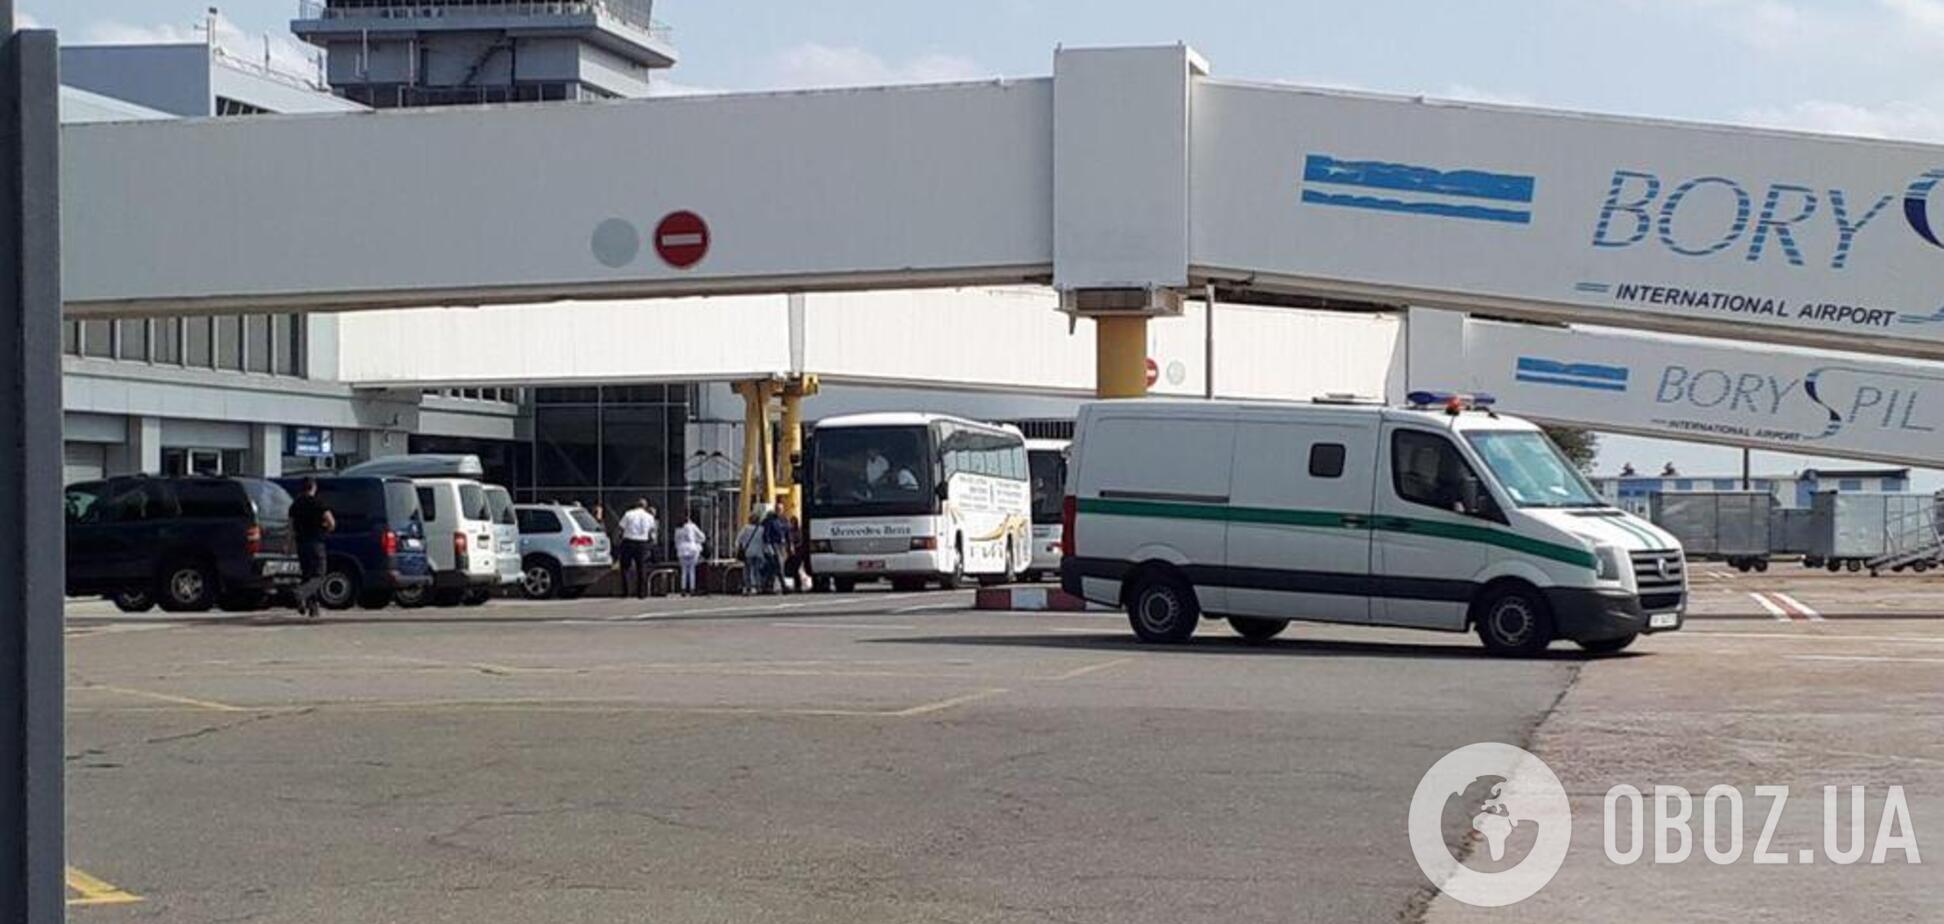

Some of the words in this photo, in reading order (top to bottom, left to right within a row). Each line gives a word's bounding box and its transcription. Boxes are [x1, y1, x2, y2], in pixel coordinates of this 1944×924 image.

[1615, 283, 1790, 318] INTERNATIONAL
[1798, 303, 1896, 328] AIRPORT
[1668, 420, 1750, 437] INTERNATIONAL
[1754, 429, 1800, 441] AIRPORT
[830, 526, 881, 537] Mercedes
